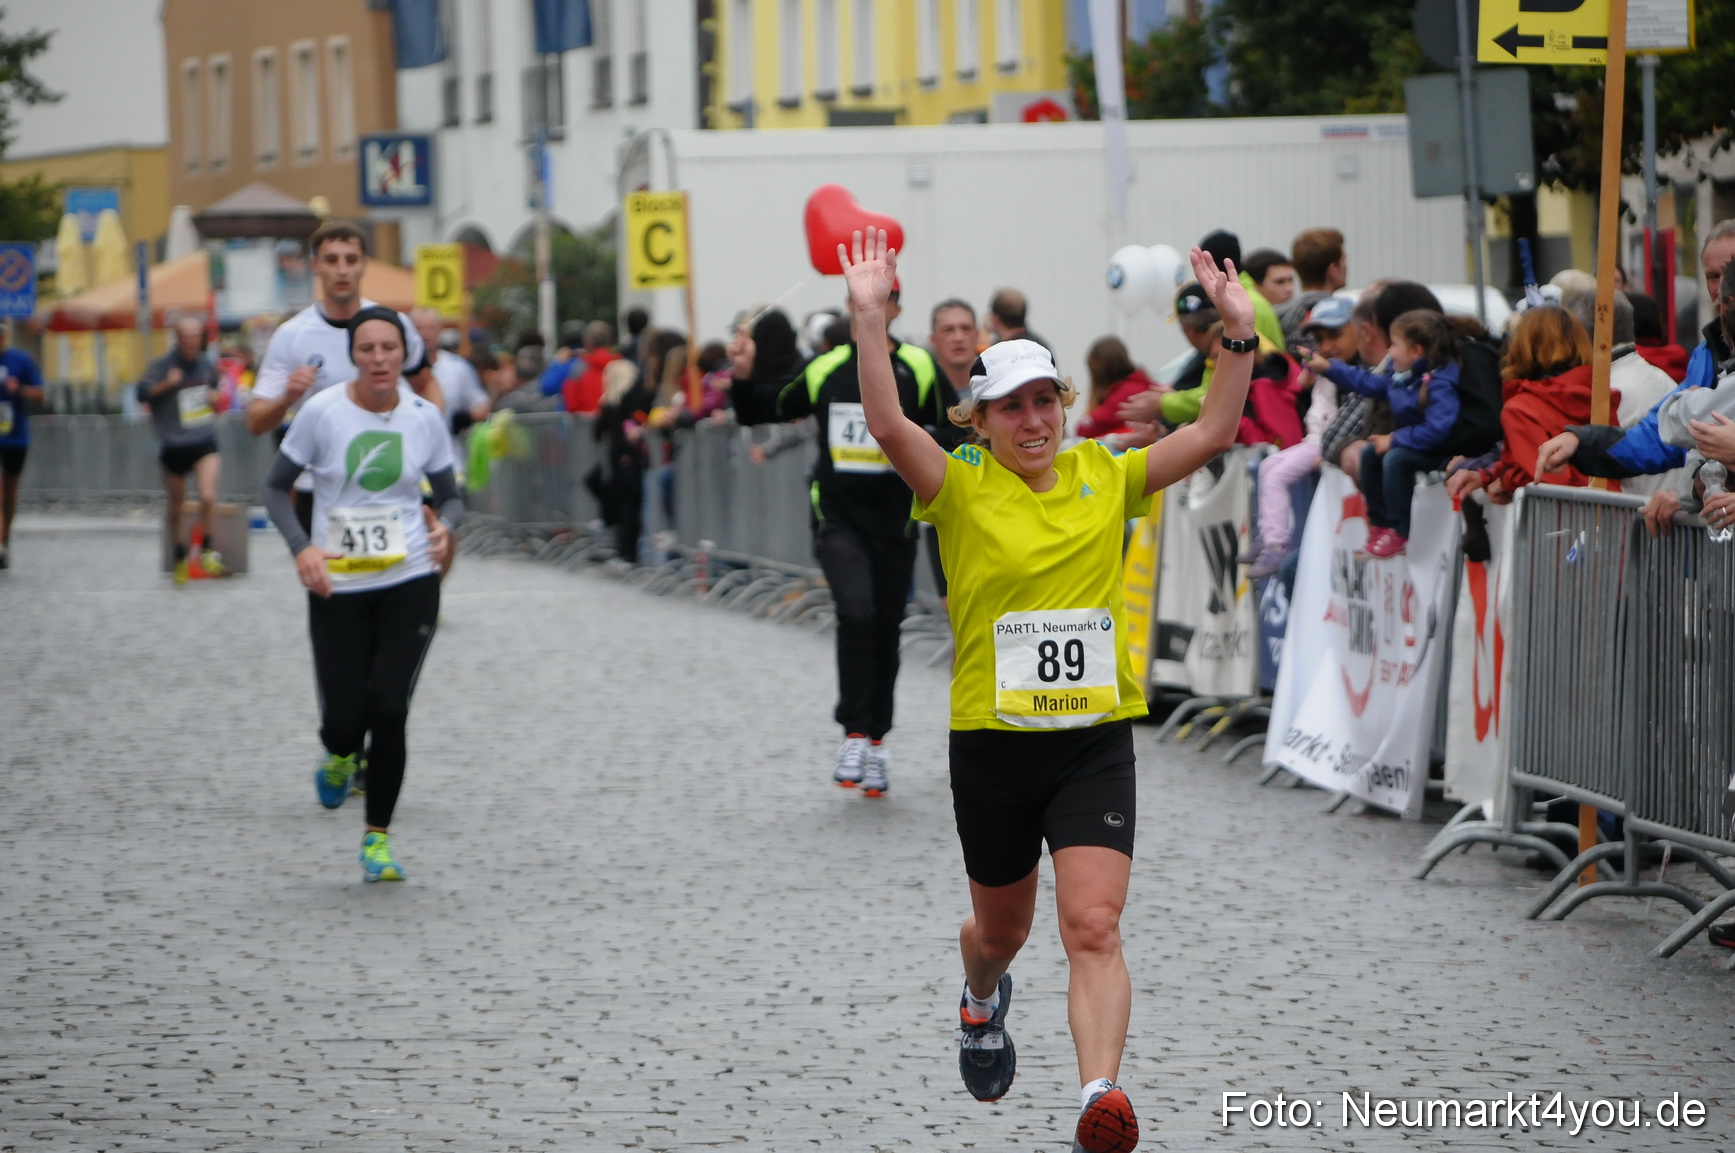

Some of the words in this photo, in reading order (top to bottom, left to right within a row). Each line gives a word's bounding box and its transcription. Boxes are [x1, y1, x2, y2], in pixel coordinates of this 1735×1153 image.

[642, 221, 674, 267] C
[427, 266, 453, 300] D
[341, 525, 388, 552] 413
[997, 622, 1040, 634] PARTL
[1043, 620, 1097, 633] Neumarkt
[1037, 638, 1085, 683] 89
[1033, 694, 1088, 711] Marion
